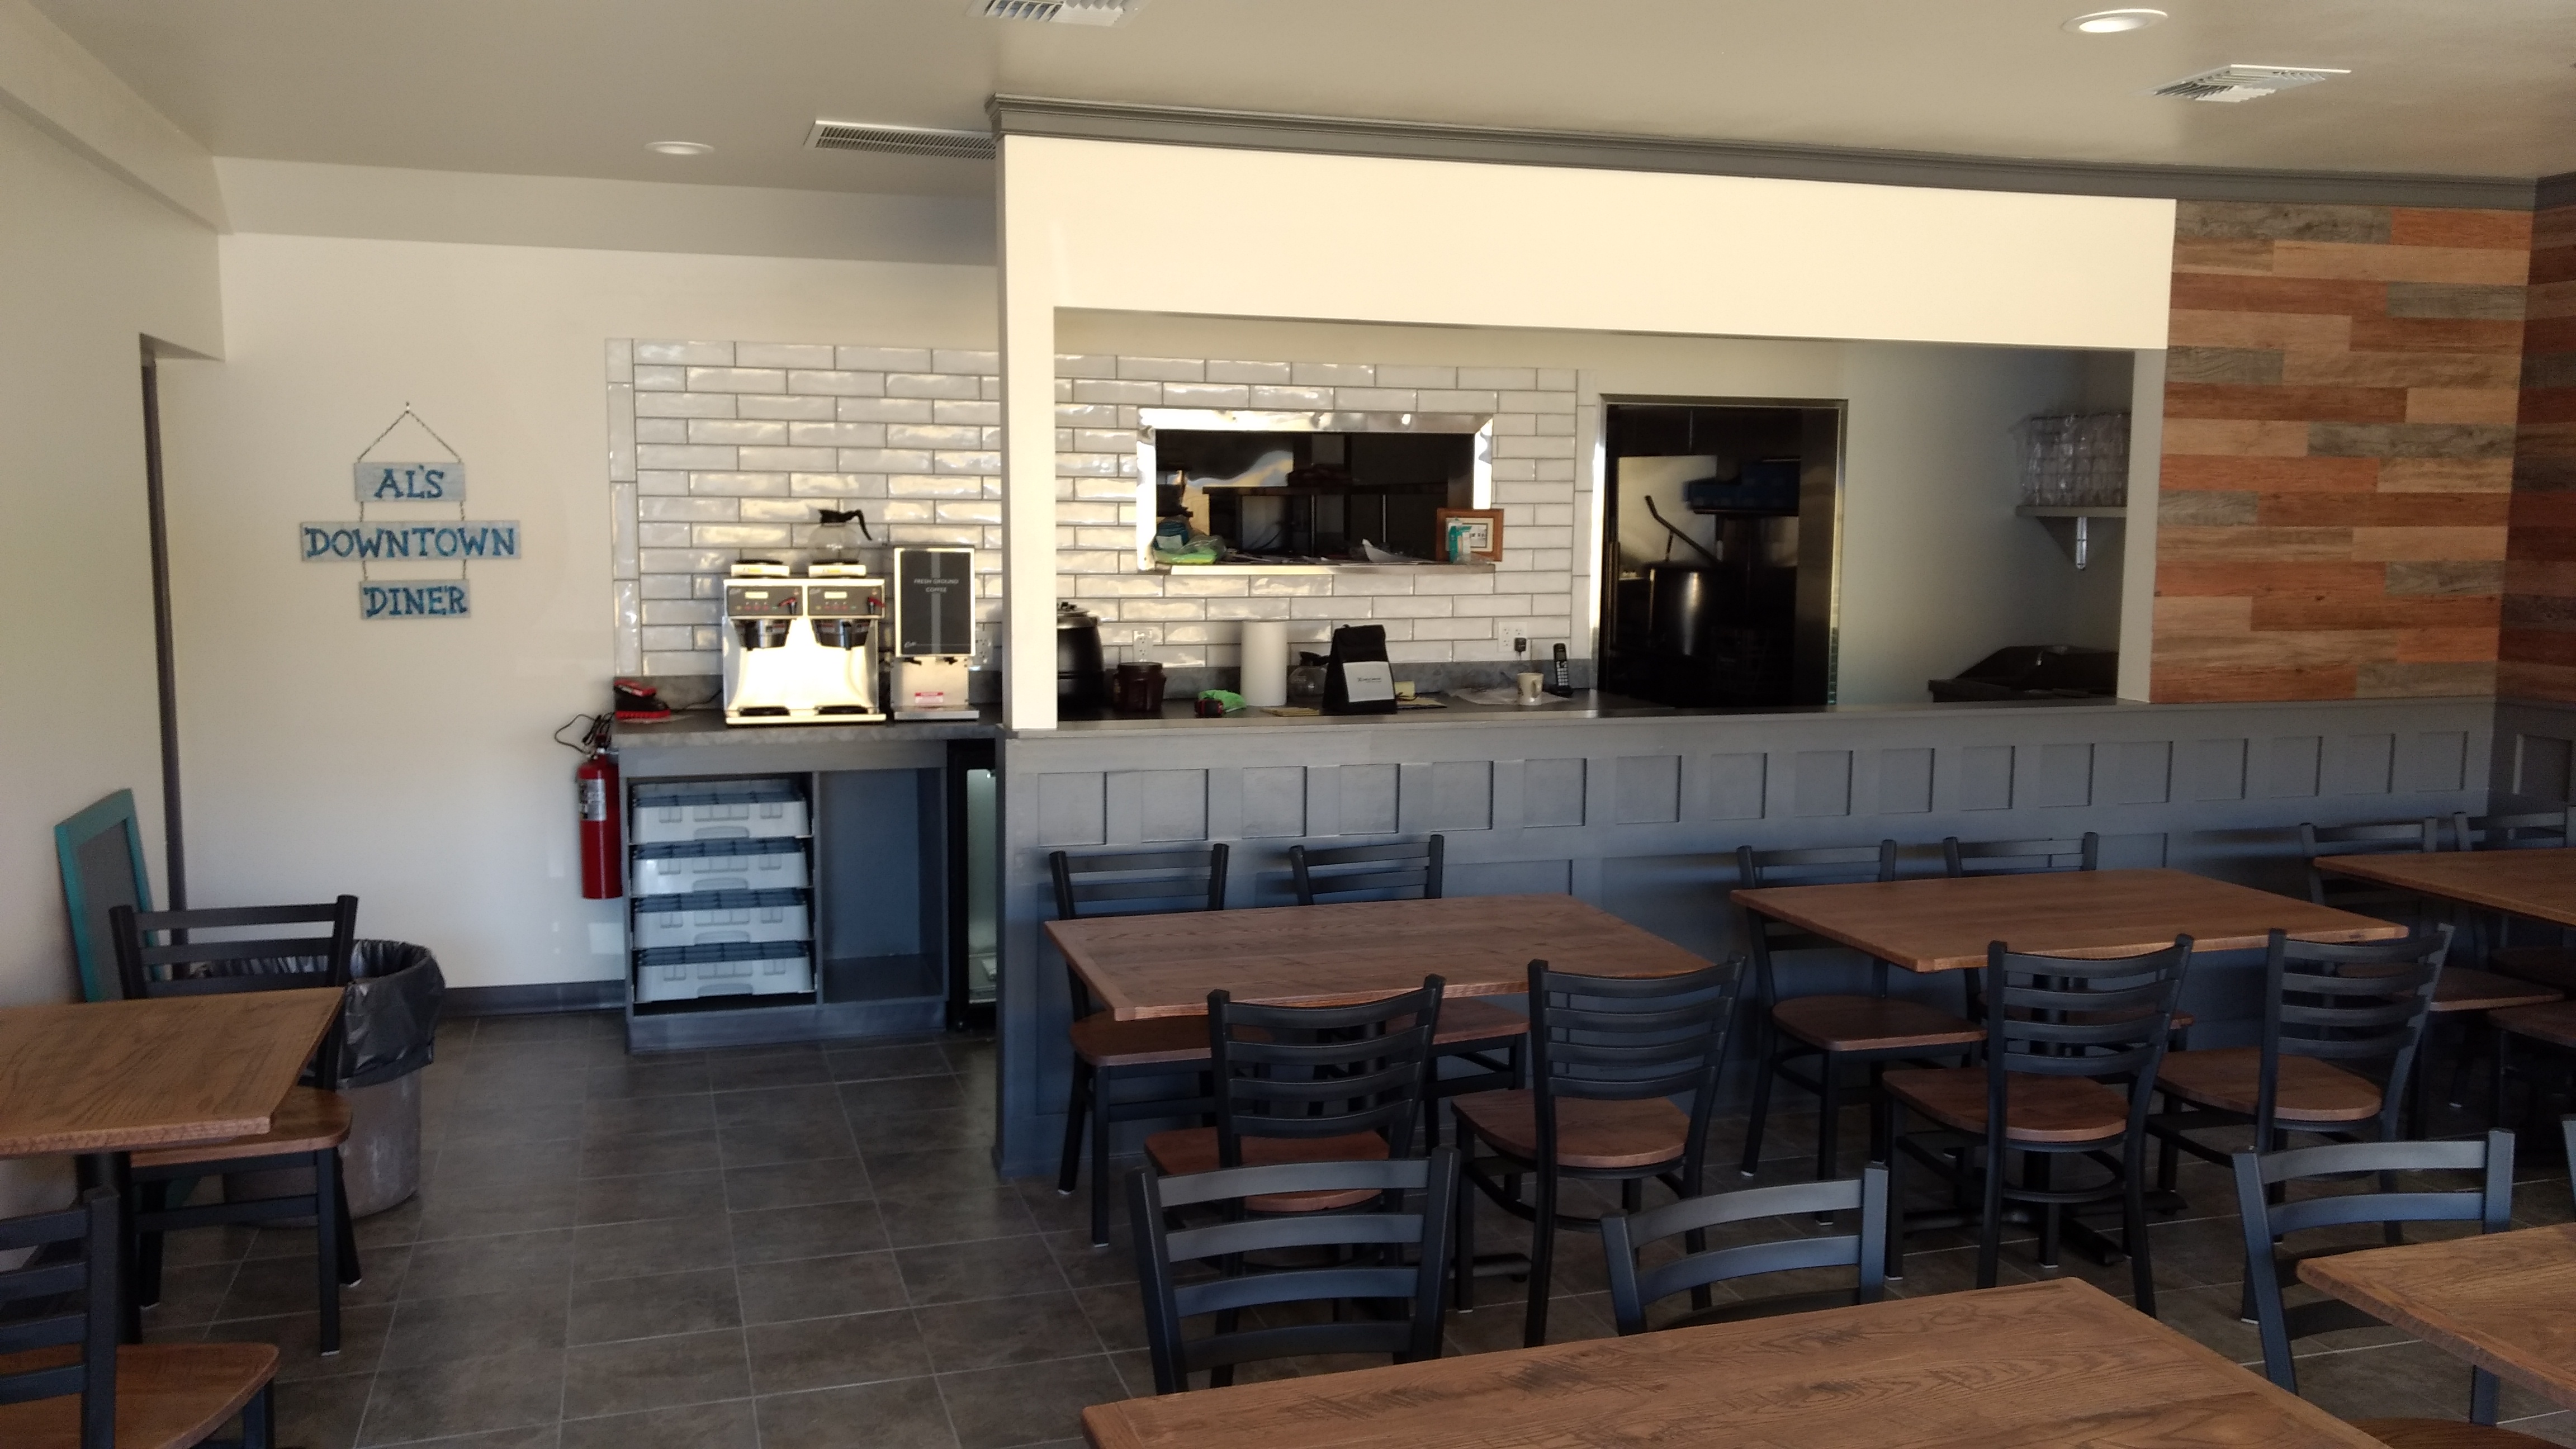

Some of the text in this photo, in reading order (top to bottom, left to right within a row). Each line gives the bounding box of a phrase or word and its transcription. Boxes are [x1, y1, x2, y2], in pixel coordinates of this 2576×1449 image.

[373, 465, 444, 499] AL'S
[304, 527, 514, 558] DOWNTOWN
[363, 585, 467, 617] DINER
